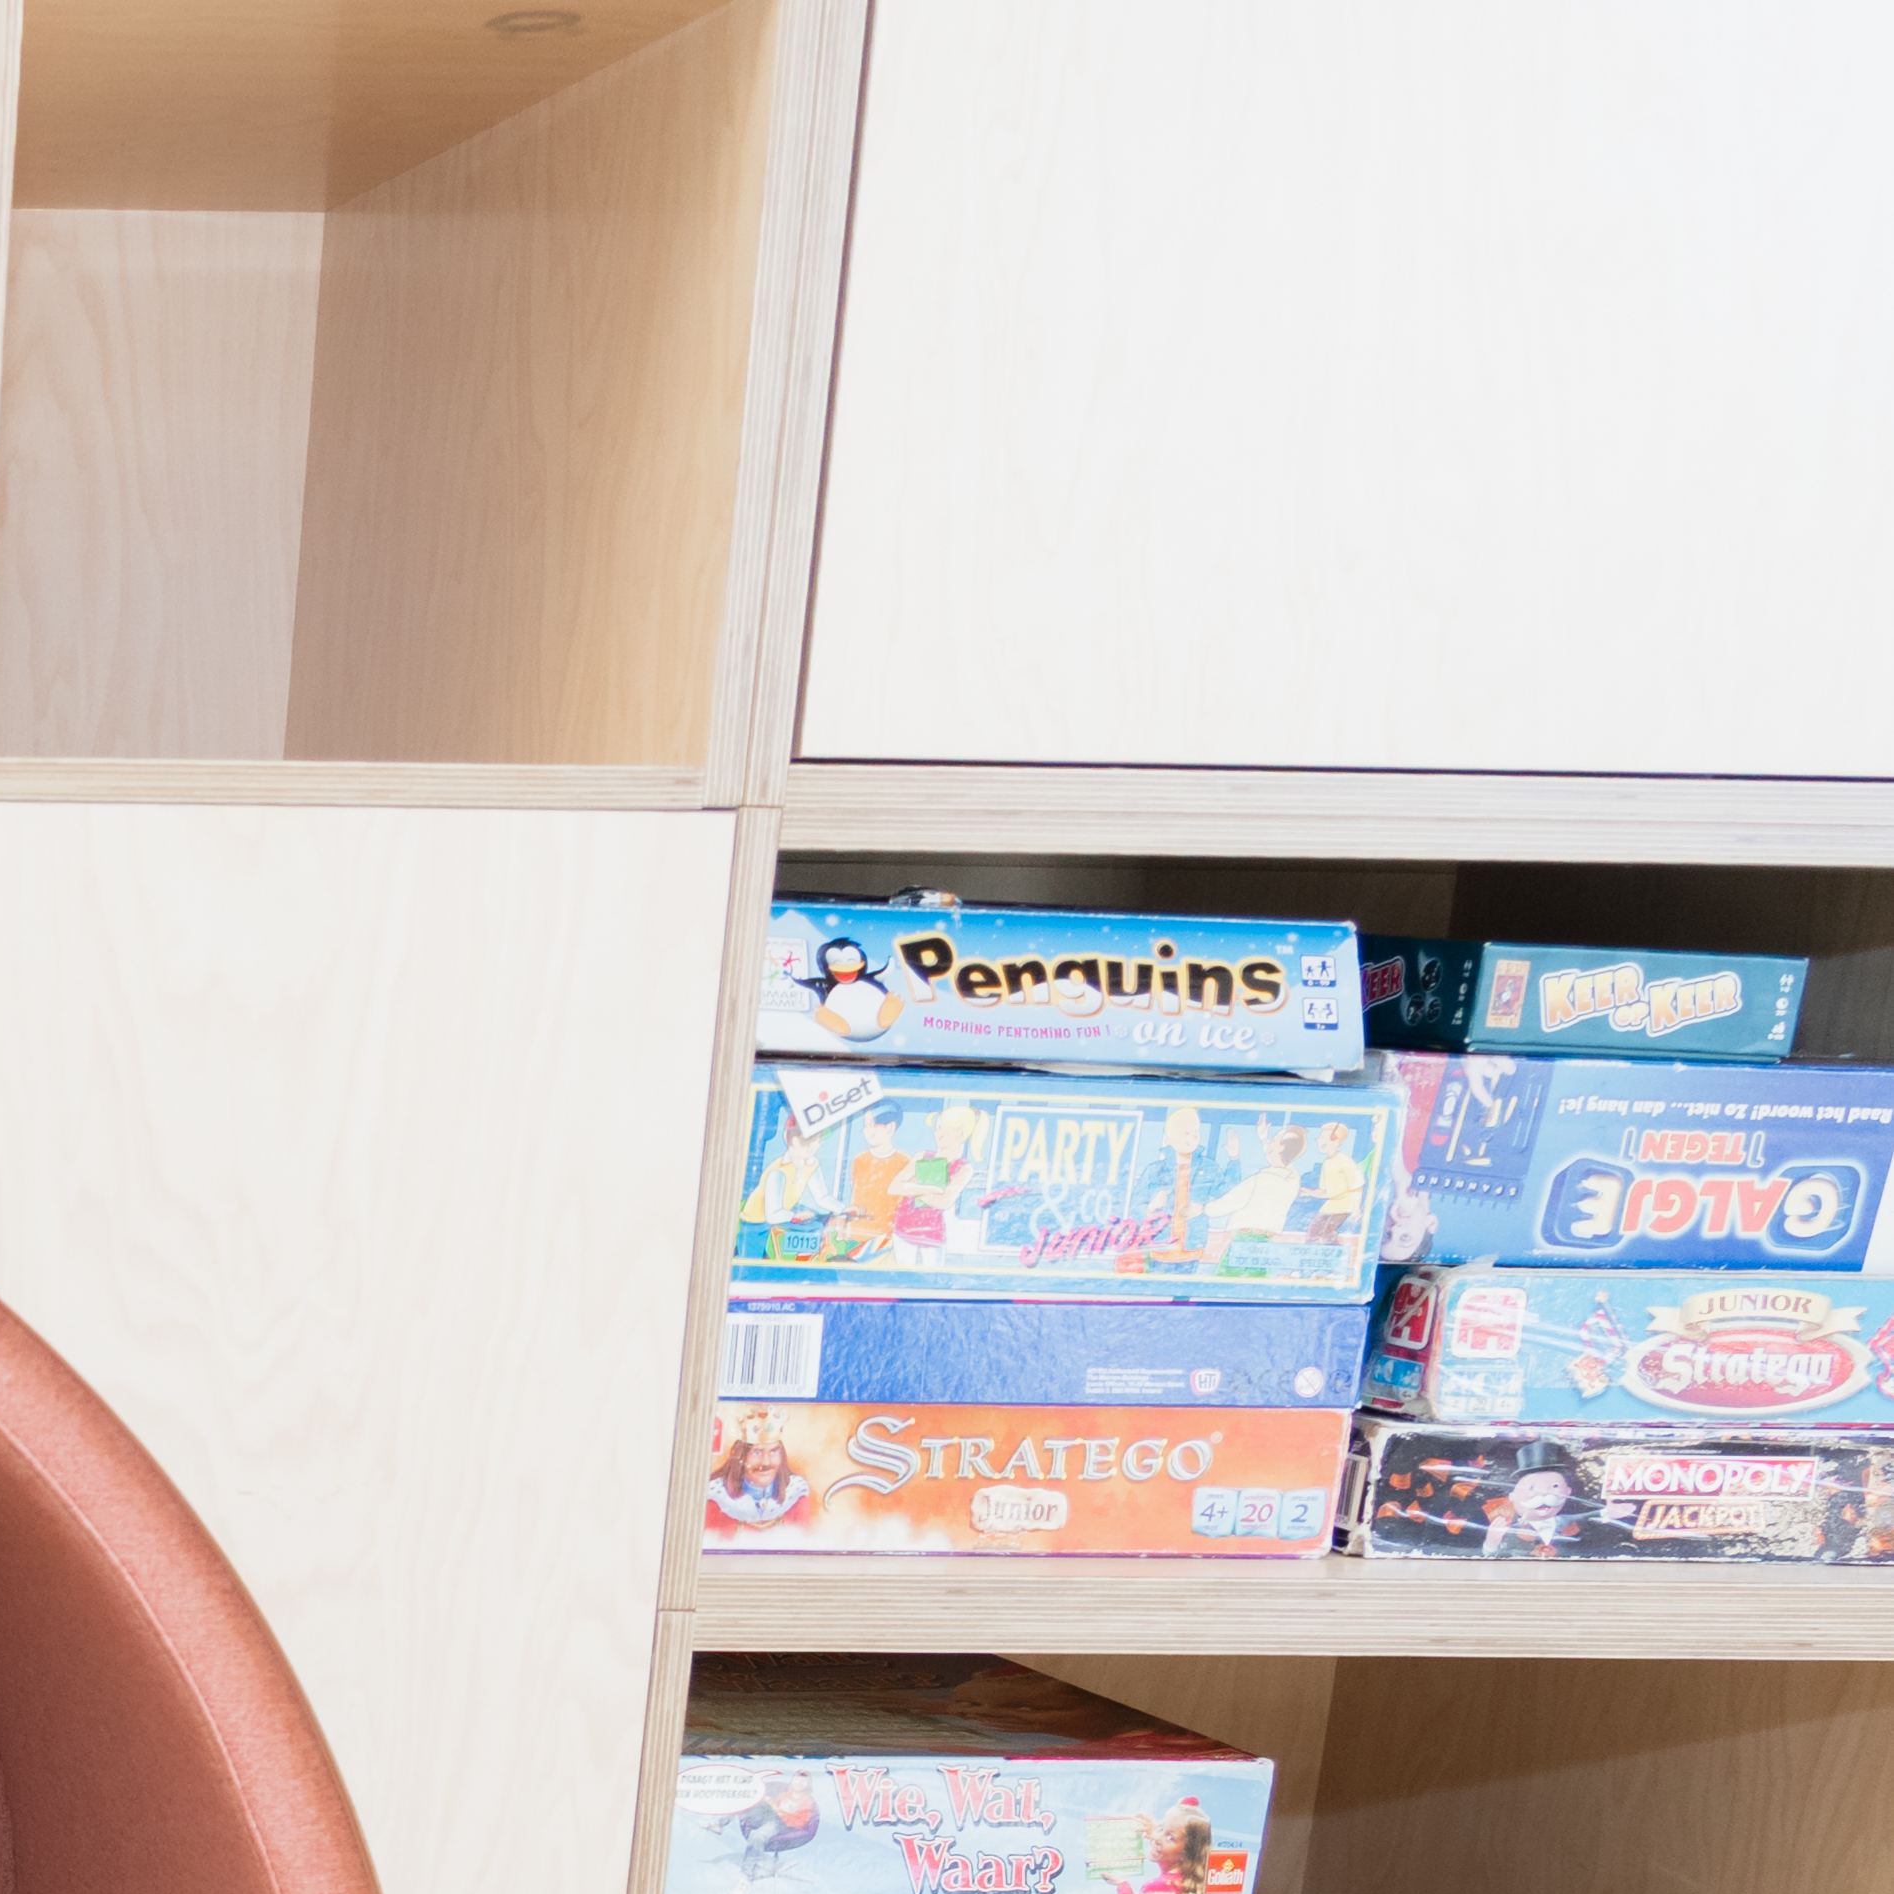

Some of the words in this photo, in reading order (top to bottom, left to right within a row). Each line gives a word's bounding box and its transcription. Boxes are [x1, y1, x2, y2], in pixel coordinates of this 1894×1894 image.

[894, 932, 1288, 1018] Penguins
[1542, 964, 1642, 1031] KEER
[1646, 972, 1741, 1037] KEER
[1077, 1027, 1101, 1038] FUN
[1132, 1020, 1186, 1048] on
[1199, 1022, 1257, 1051] ice
[802, 1077, 872, 1126] Diset
[1558, 1097, 1584, 1115] je!
[1586, 1096, 1626, 1116] hang
[1632, 1100, 1666, 1117] dan
[1725, 1103, 1749, 1119] Zo
[1751, 1104, 1813, 1121] woord!
[1817, 1106, 1842, 1122] het
[1847, 1107, 1893, 1124] Raad
[999, 1117, 1134, 1185] PARTY
[1638, 1130, 1747, 1165] TEGEN
[1571, 1173, 1840, 1238] GALGJE
[786, 1235, 817, 1250] 10113
[1699, 1294, 1813, 1315] JUNIOR
[1653, 1342, 1835, 1397] Stratego
[825, 1415, 1213, 1511] STRATEGO
[1611, 1461, 1812, 1494] MONOPOLY
[978, 1494, 1058, 1525] Junior
[1199, 1502, 1229, 1522] 4+
[1240, 1503, 1274, 1523] 20
[1290, 1503, 1309, 1523] 2
[1645, 1504, 1761, 1530] JACKPOT
[826, 1764, 942, 1834] Wie,
[937, 1764, 1056, 1835] Wat,
[1207, 1869, 1244, 1885] Goliath
